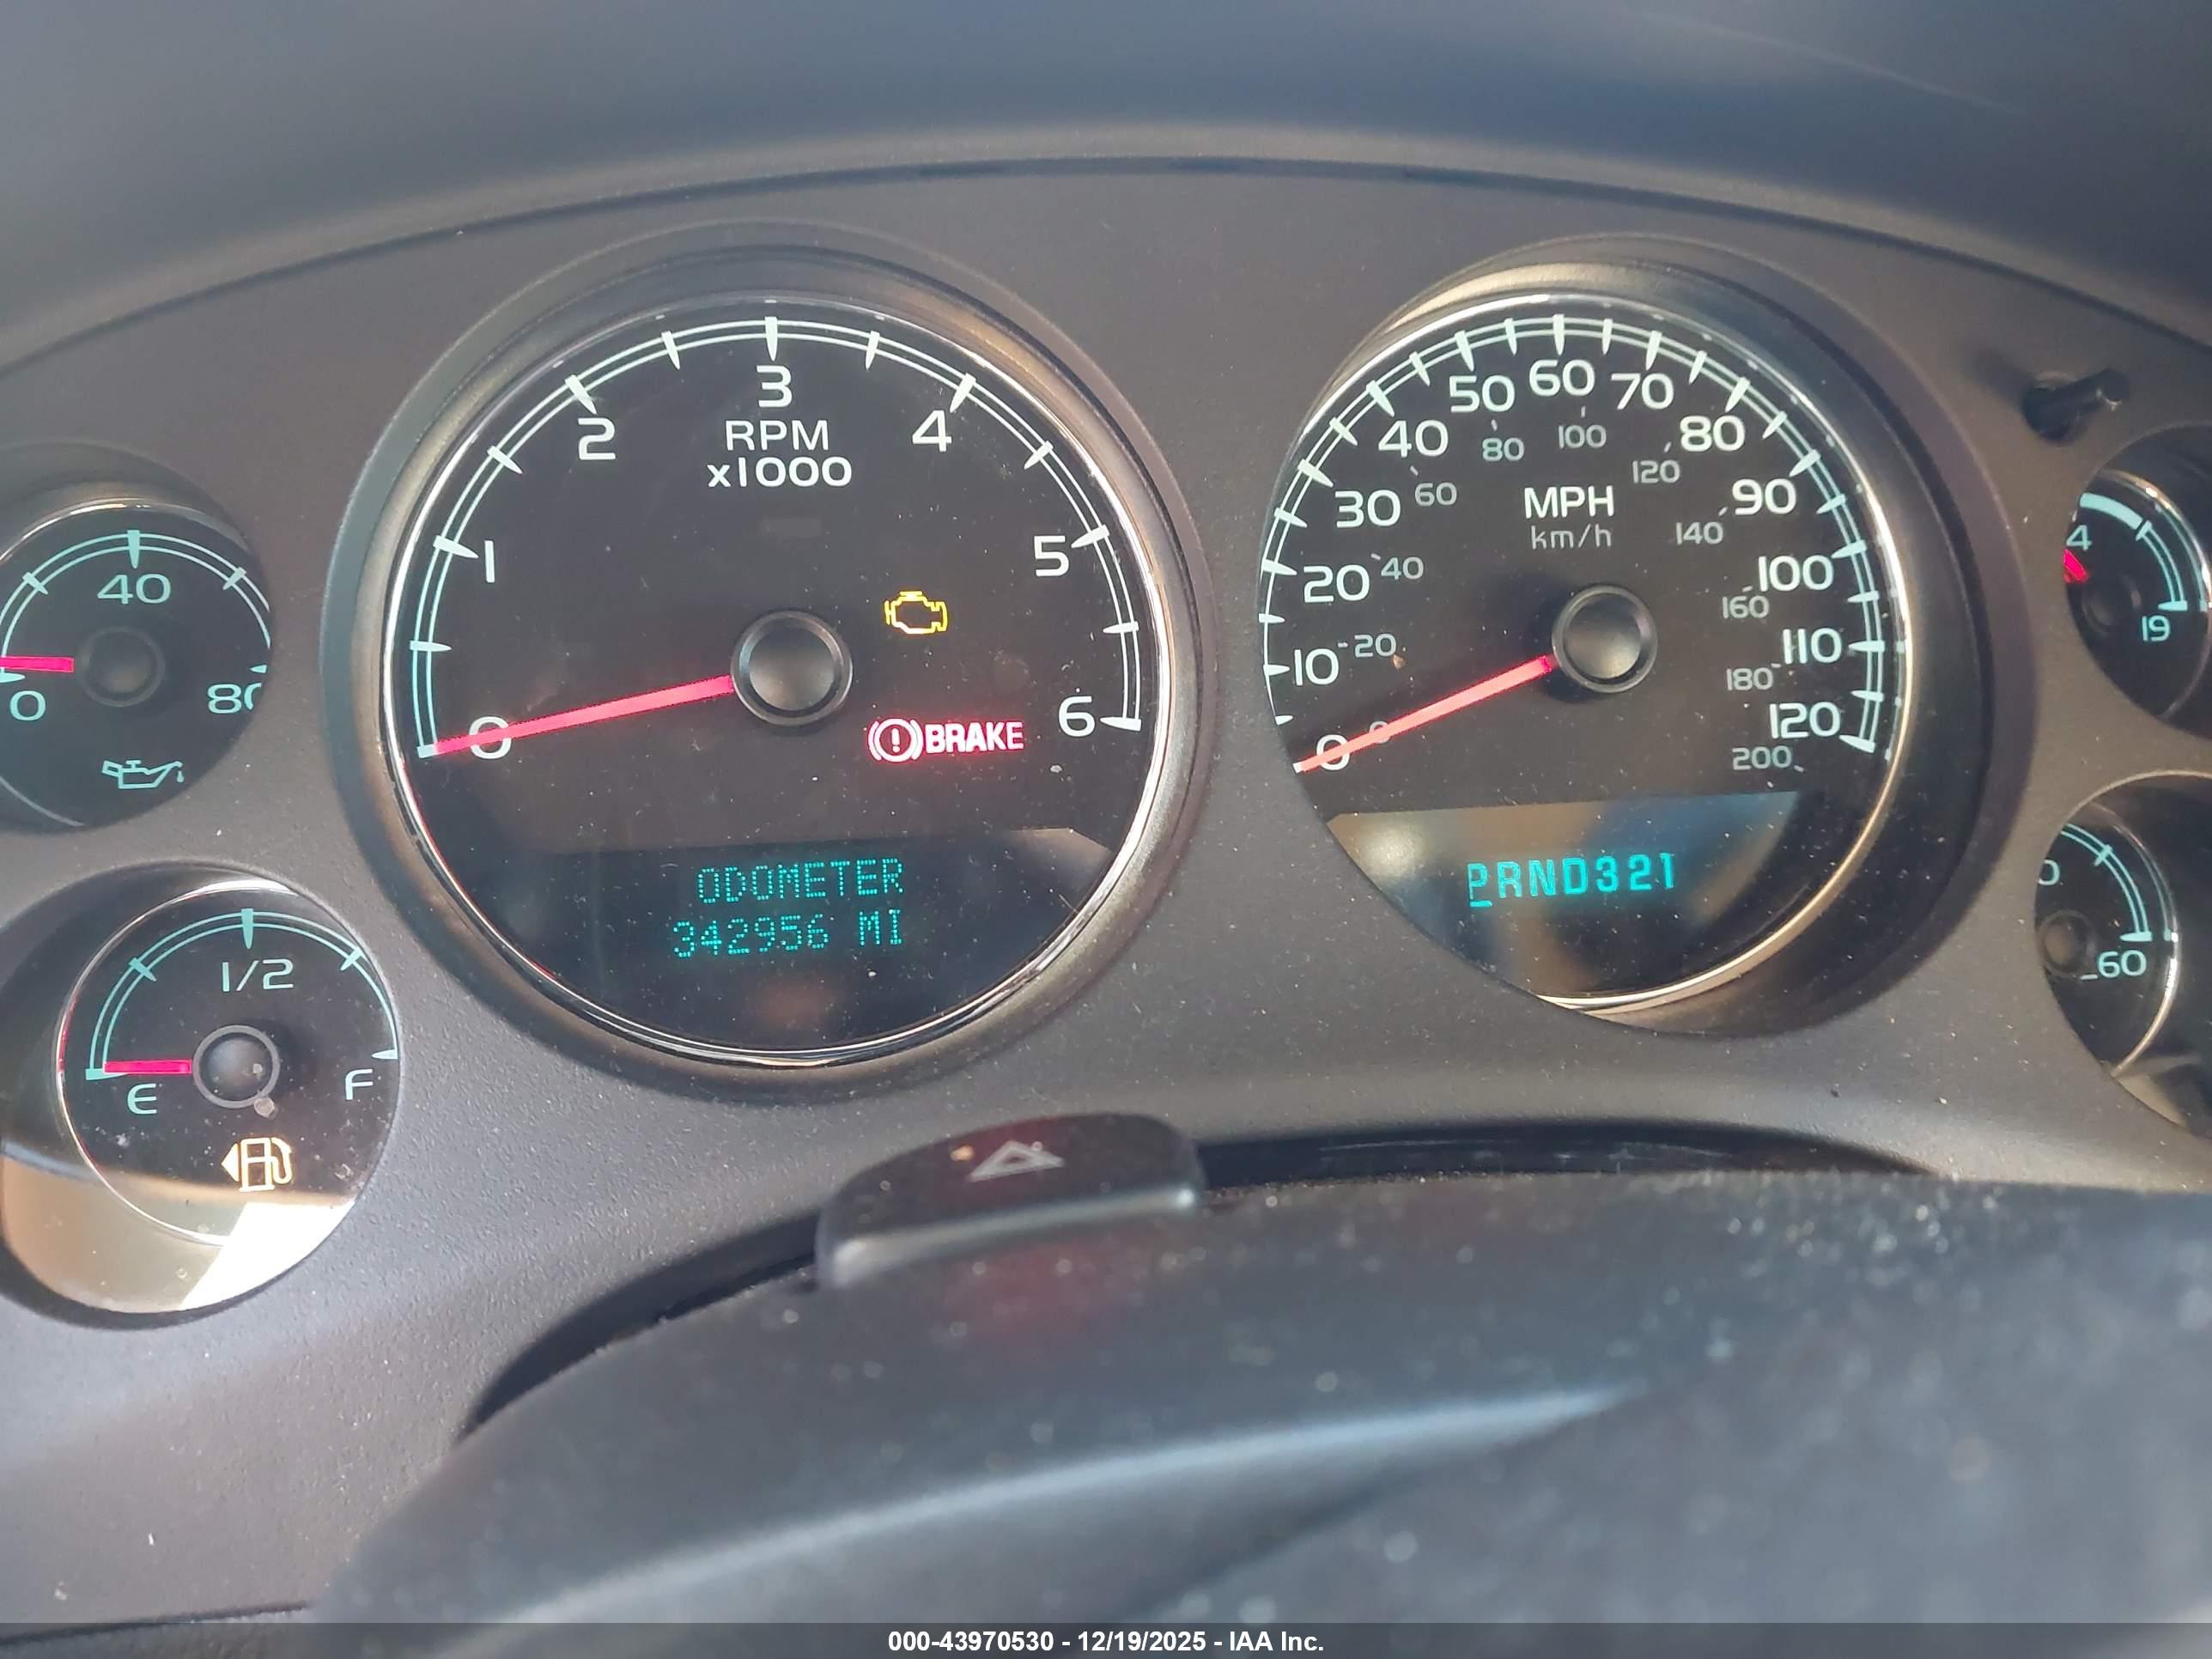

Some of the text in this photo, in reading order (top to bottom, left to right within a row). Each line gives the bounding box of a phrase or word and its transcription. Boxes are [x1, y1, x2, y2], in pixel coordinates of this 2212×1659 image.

[757, 365, 793, 409] 3
[1449, 374, 1515, 413] 50
[1529, 359, 1595, 397] 60
[1611, 373, 1674, 410] 70
[578, 418, 617, 462] 2
[726, 419, 830, 450] RPM
[912, 410, 952, 453] 4
[1378, 420, 1449, 459] 40
[1482, 437, 1525, 462] 80
[1559, 424, 1607, 449] 100
[1680, 416, 1746, 453] 80
[707, 456, 853, 489] x1000
[1632, 459, 1680, 484] 120
[1335, 489, 1401, 528] 30
[1415, 482, 1457, 507] 60
[1524, 485, 1614, 519] MPH
[1732, 478, 1796, 515] 90
[1531, 523, 1612, 550] km/h
[1676, 521, 1723, 545] 140
[483, 540, 497, 583] 1
[1035, 536, 1071, 577] 5
[1381, 556, 1424, 580] 40
[1758, 555, 1833, 592] 100
[97, 574, 171, 605] 40
[1304, 563, 1370, 604] 20
[1723, 595, 1769, 619] 160
[1354, 633, 1397, 658] 20
[2142, 615, 2171, 641] 19
[1783, 629, 1841, 665] 110
[1294, 648, 1340, 686] 10
[1727, 667, 1773, 691] 180
[9, 690, 46, 721] 0
[1057, 696, 1096, 737] 6
[1769, 701, 1840, 739] 120
[469, 716, 513, 760] 0
[925, 721, 1024, 754] BRAKE
[1316, 734, 1350, 770] 0
[1732, 745, 1792, 771] 200
[697, 858, 903, 903] ODOMETER
[673, 909, 902, 957] 342956 MI
[222, 958, 294, 993] 1/2
[127, 1083, 157, 1115] E
[345, 1068, 373, 1100] F
